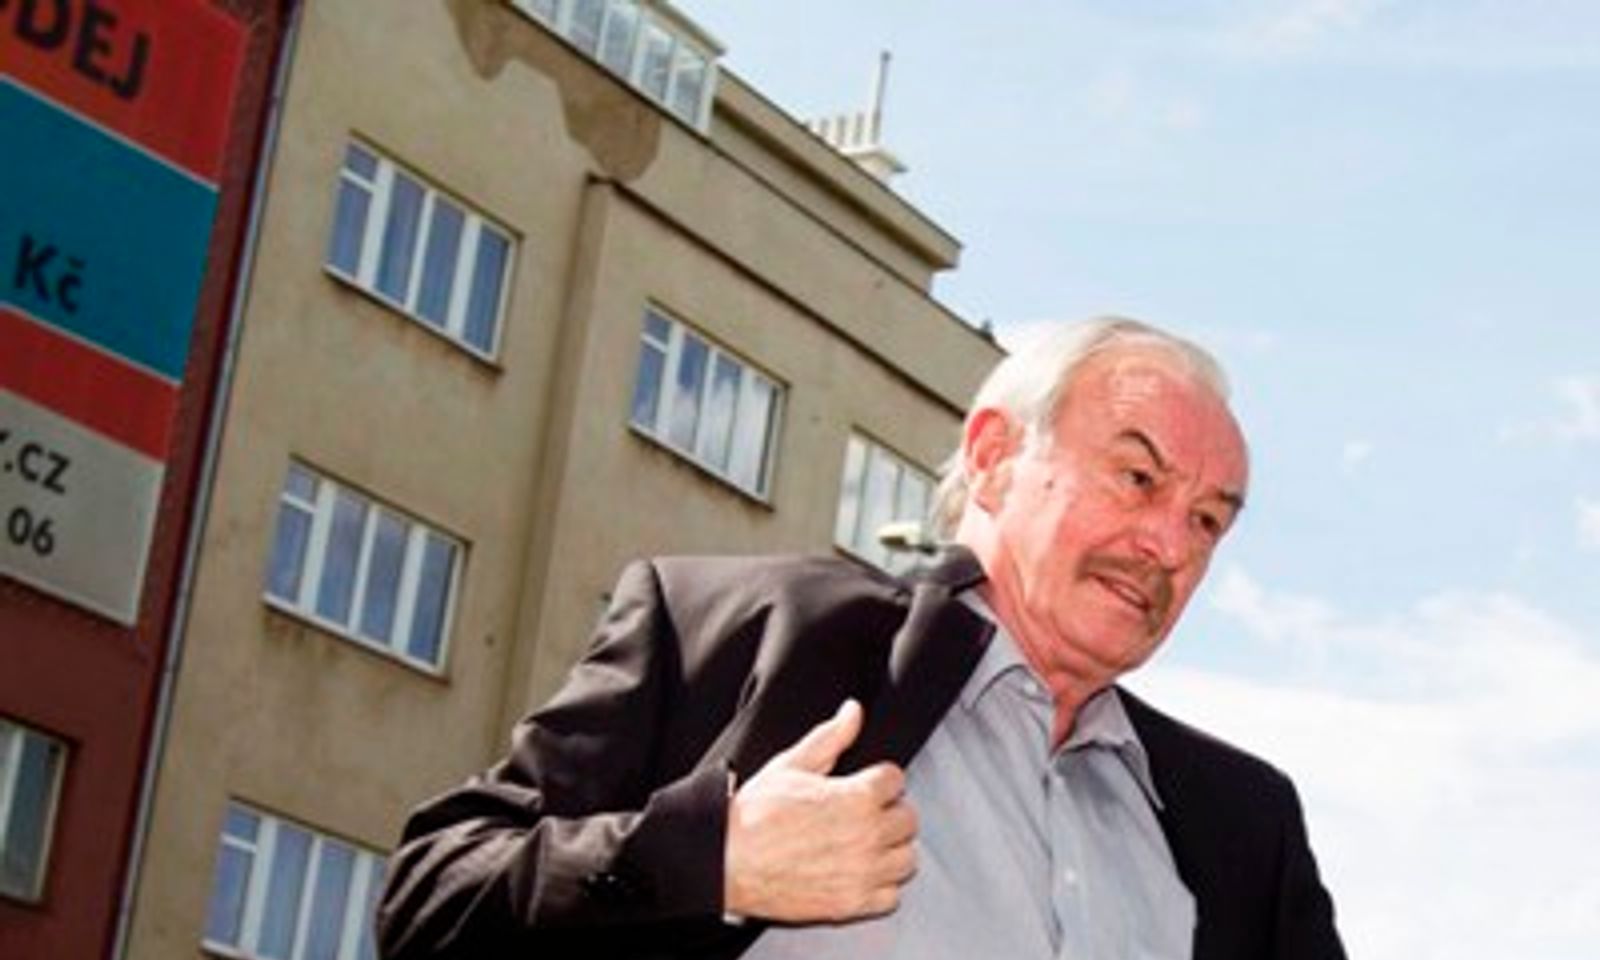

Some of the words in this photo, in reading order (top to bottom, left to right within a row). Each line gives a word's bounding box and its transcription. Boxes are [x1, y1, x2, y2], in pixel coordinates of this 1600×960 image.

[0, 0, 151, 101] DEJ
[13, 233, 86, 314] Kč
[0, 428, 71, 495] .CZ
[7, 505, 55, 557] 06
